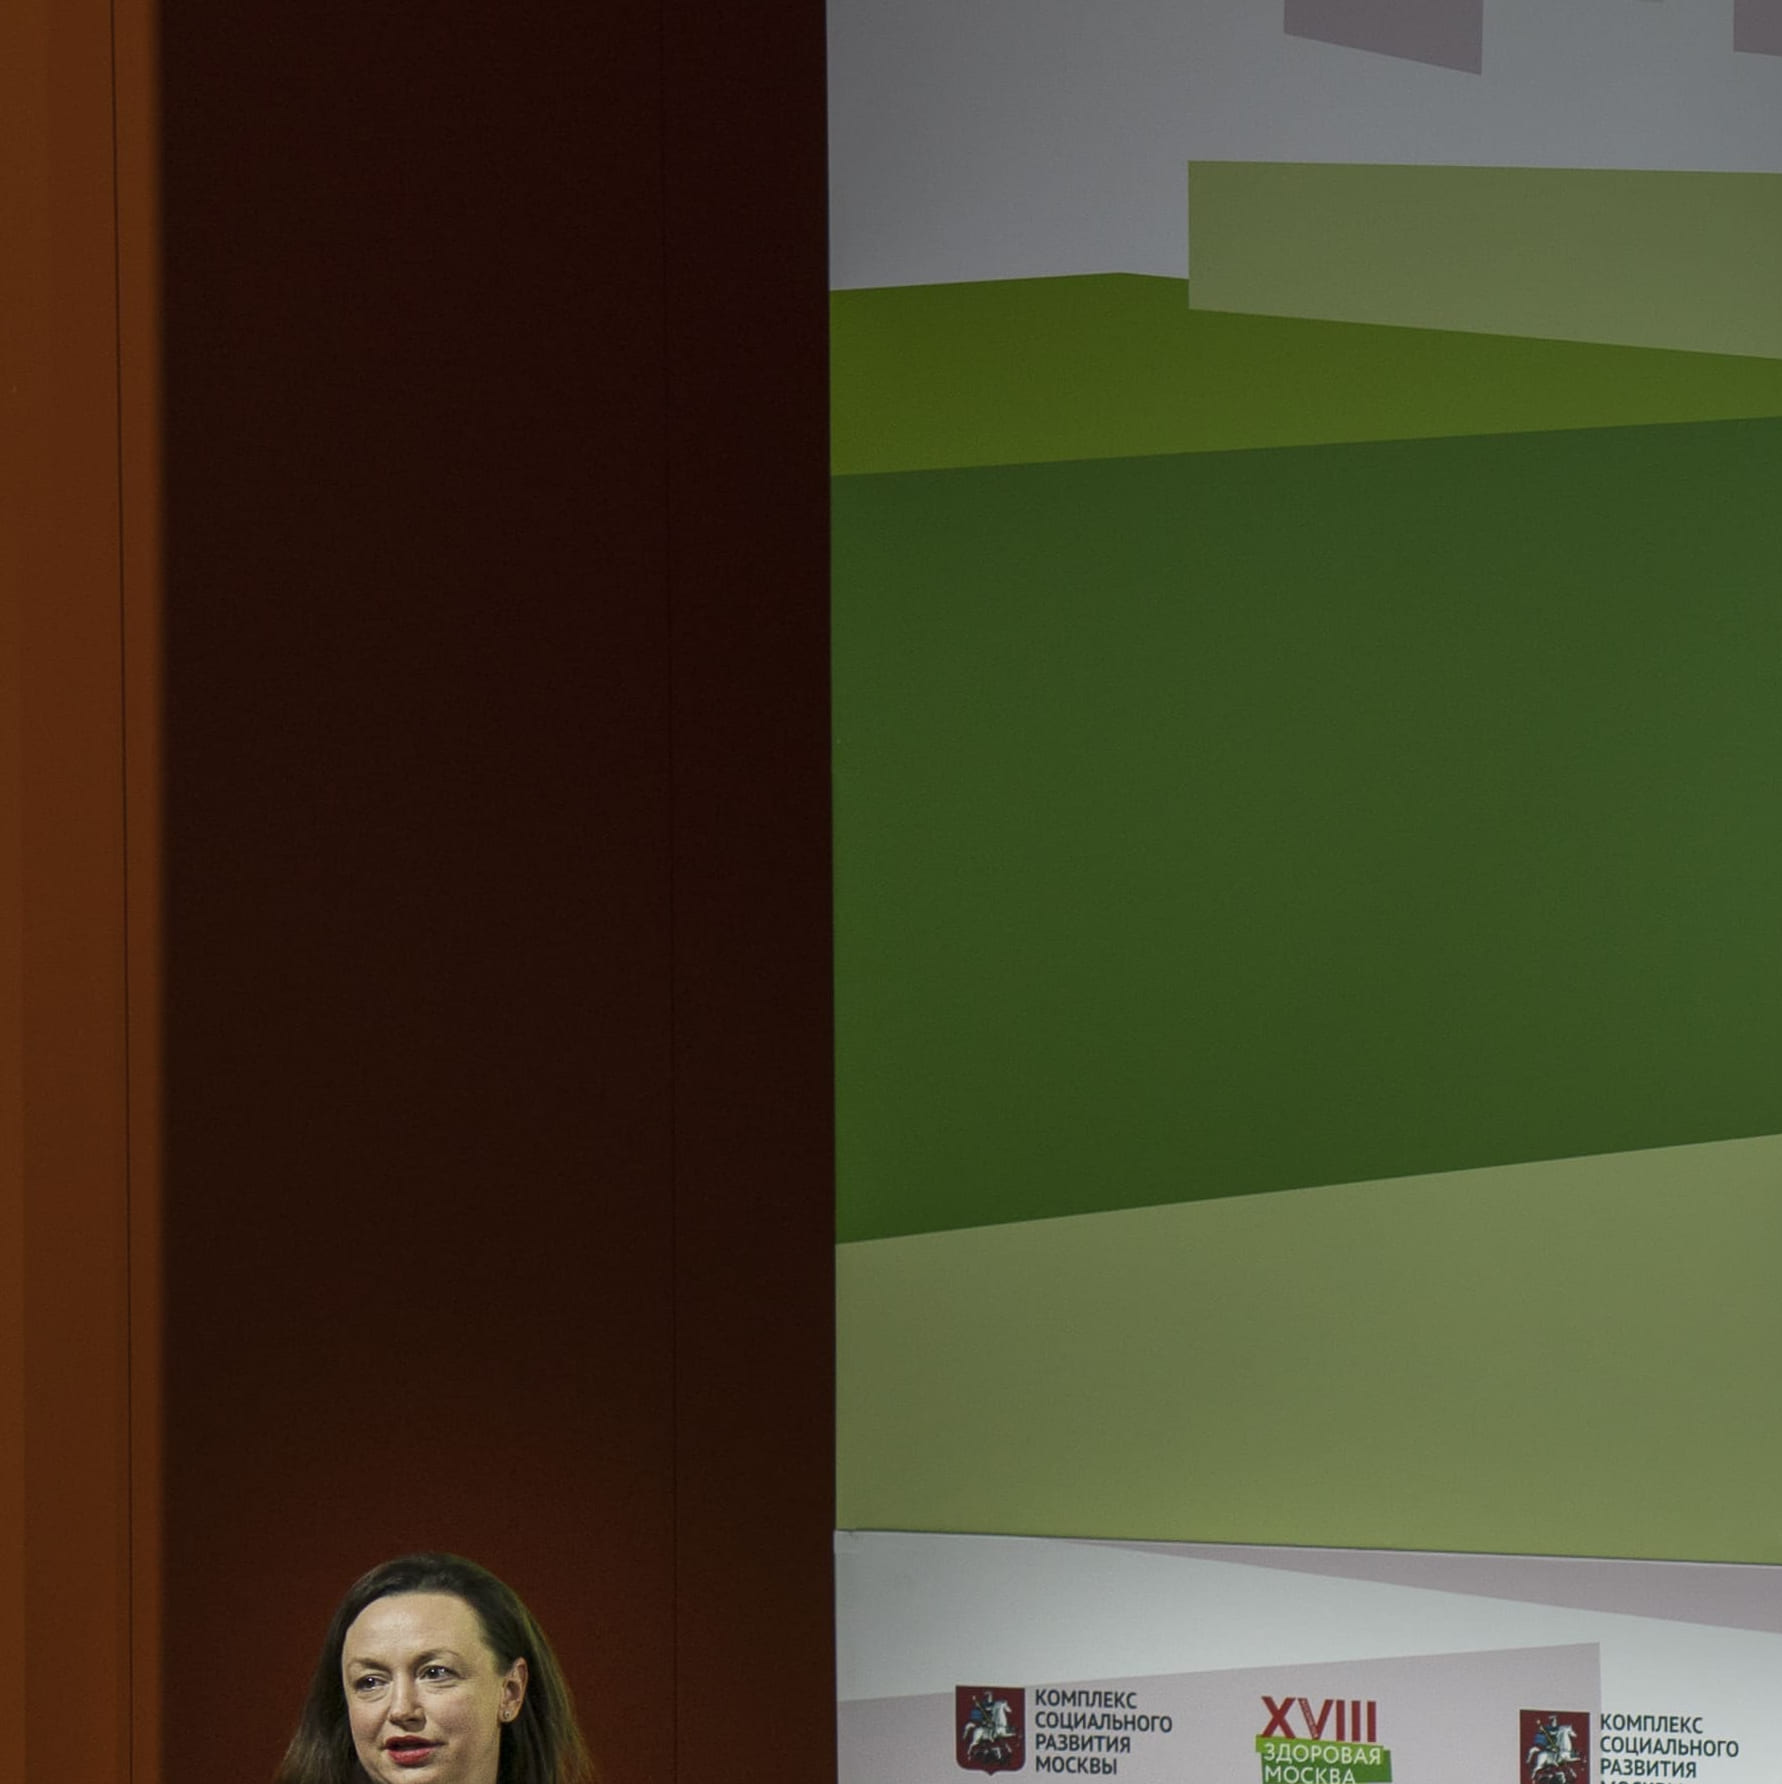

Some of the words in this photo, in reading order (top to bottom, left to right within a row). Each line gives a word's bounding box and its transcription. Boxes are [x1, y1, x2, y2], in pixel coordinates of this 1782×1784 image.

[1034, 1688, 1138, 1710] КОМПЛЕКС
[1034, 1710, 1173, 1734] СОЦИАЛЬНОГО
[1262, 1696, 1376, 1743] XVIII
[1035, 1732, 1131, 1754] РАЗВИТИЯ
[1263, 1743, 1382, 1763] ЗДОРОВАЯ
[1035, 1755, 1118, 1775] МОСКВЫ
[1264, 1764, 1357, 1783] МОСКВА
